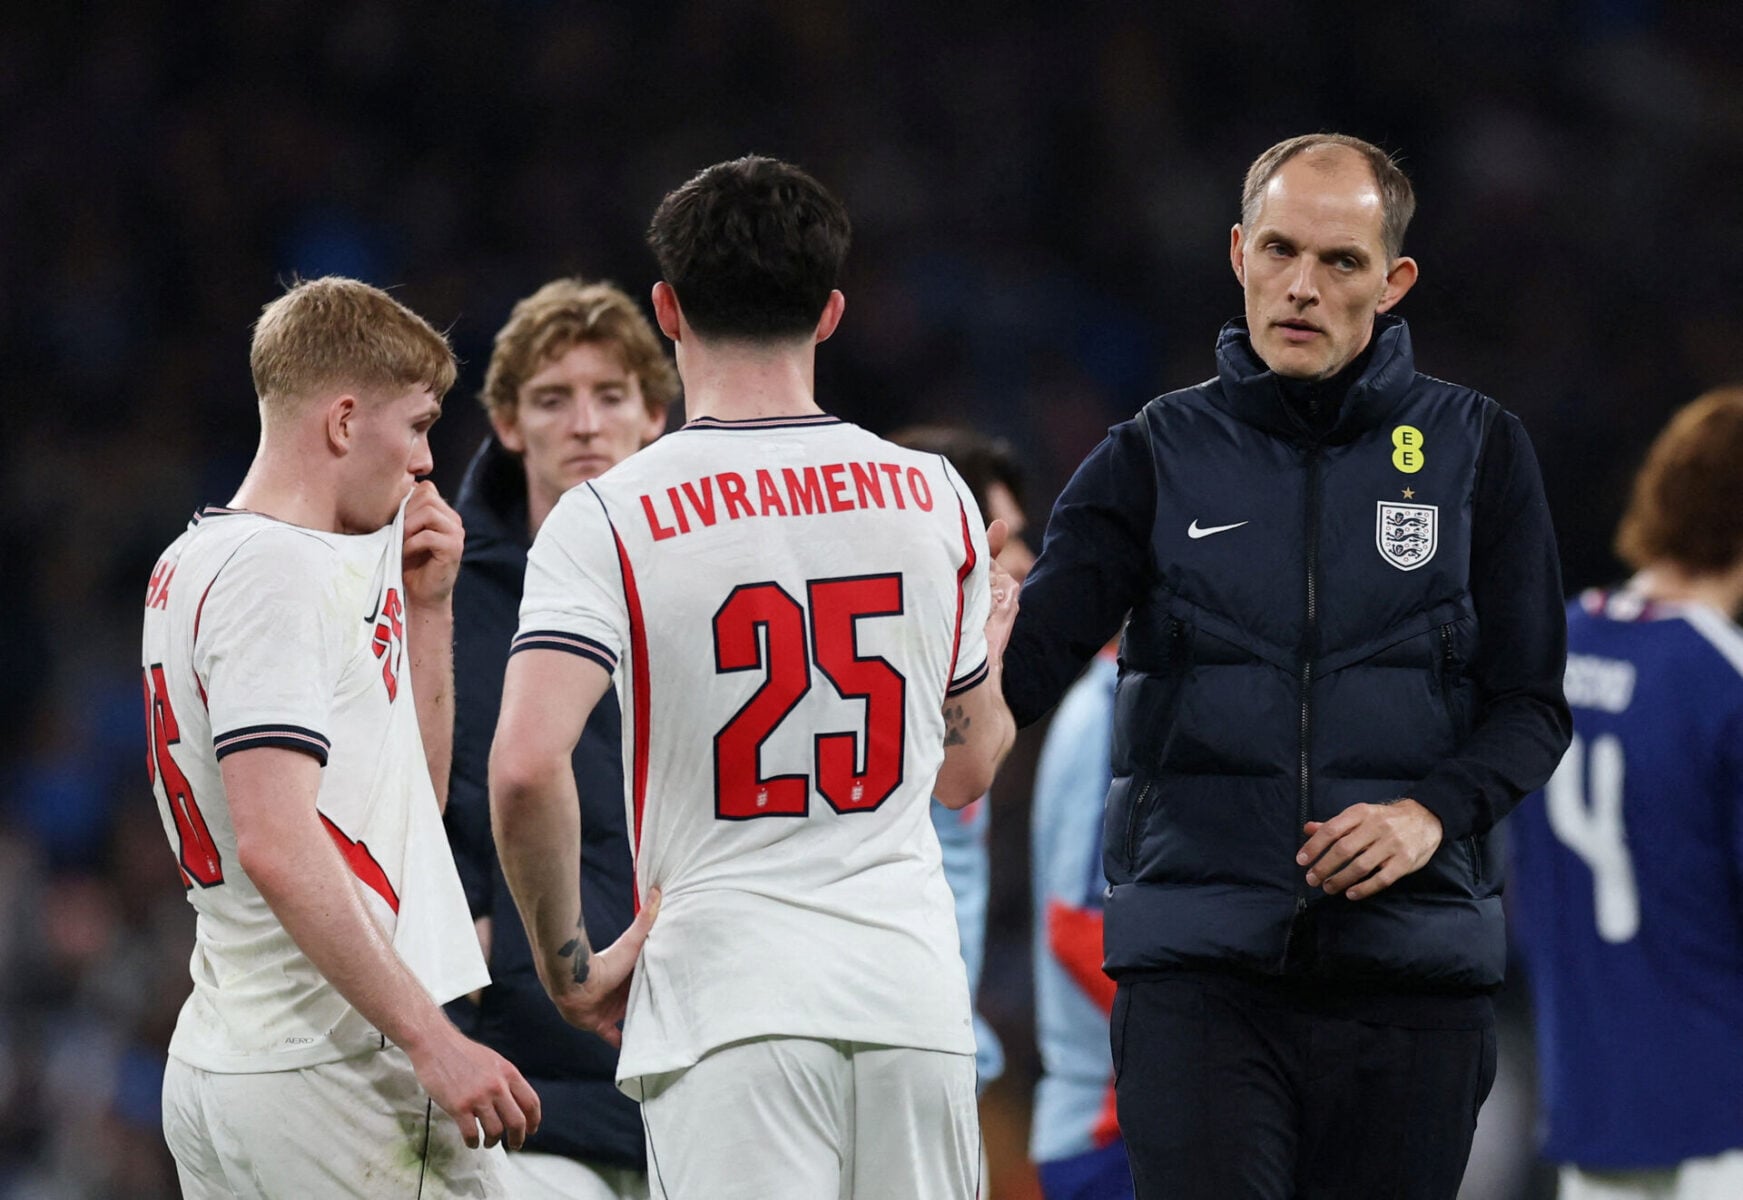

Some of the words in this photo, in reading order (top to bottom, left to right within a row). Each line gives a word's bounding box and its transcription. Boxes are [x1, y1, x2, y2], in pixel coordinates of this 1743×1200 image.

[640, 461, 934, 542] LIVRAMENTO
[712, 572, 906, 820] 25
[1545, 731, 1641, 944] 4
